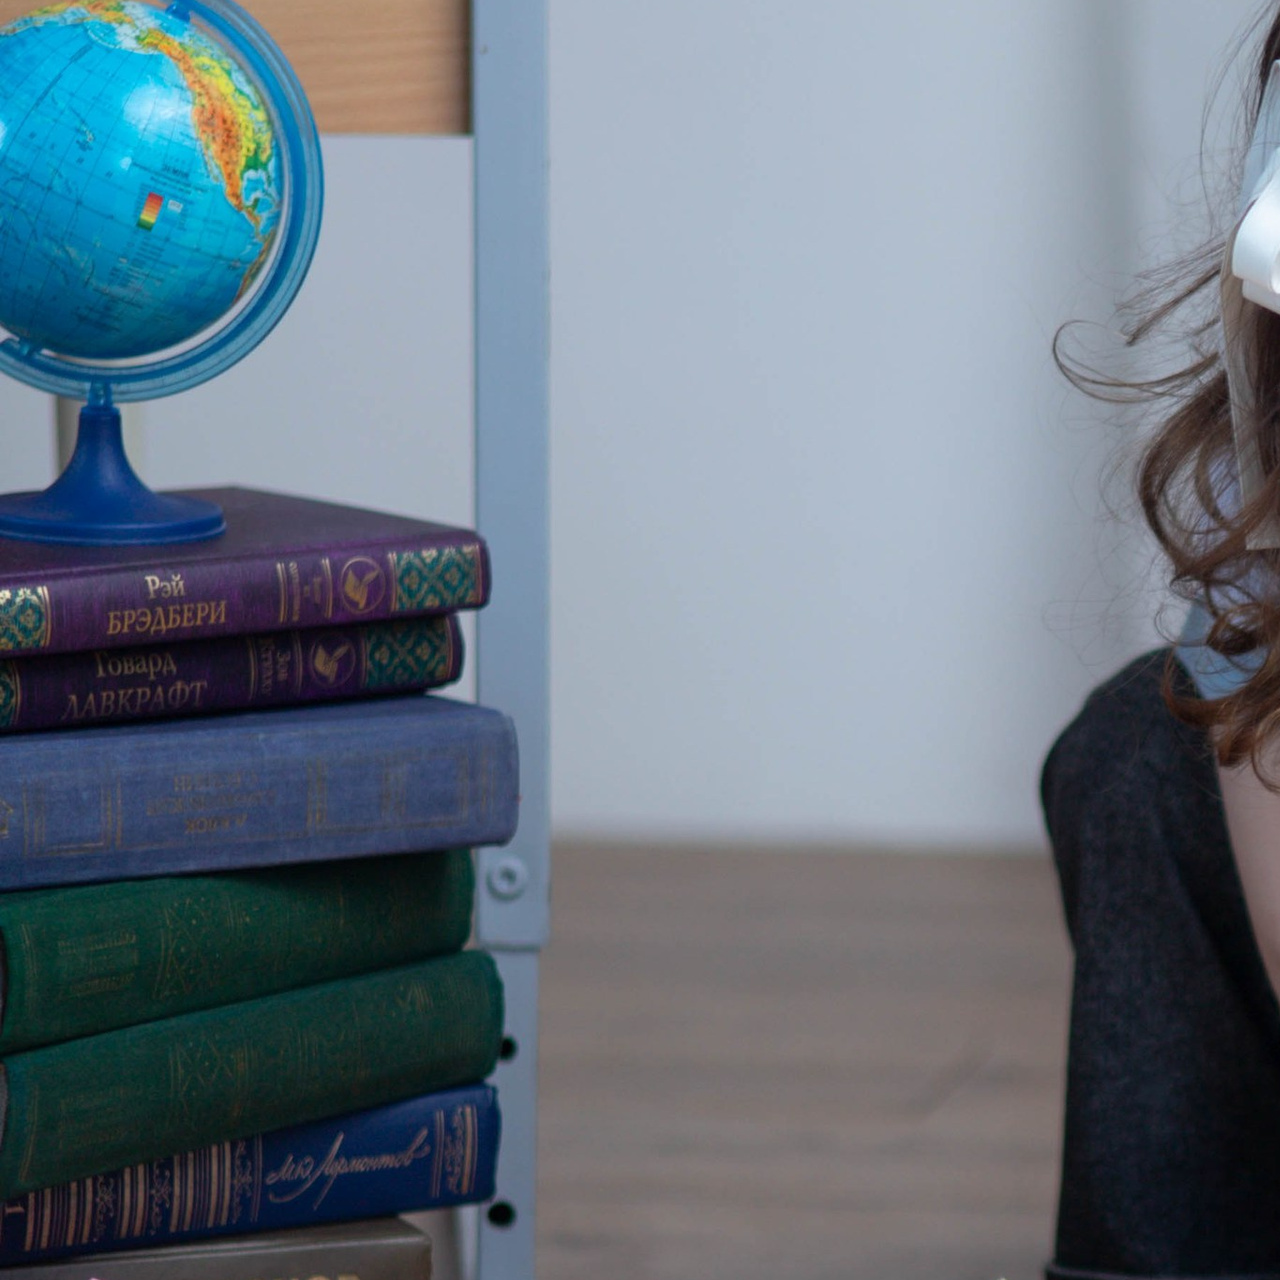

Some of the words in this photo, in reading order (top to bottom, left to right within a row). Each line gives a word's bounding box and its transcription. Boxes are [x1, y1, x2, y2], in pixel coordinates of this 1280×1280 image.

[145, 572, 186, 600] Рэй
[107, 601, 227, 636] БРЭДБЕРИ
[94, 650, 177, 681] Говард
[61, 680, 208, 721] ЛАВКРАФТ
